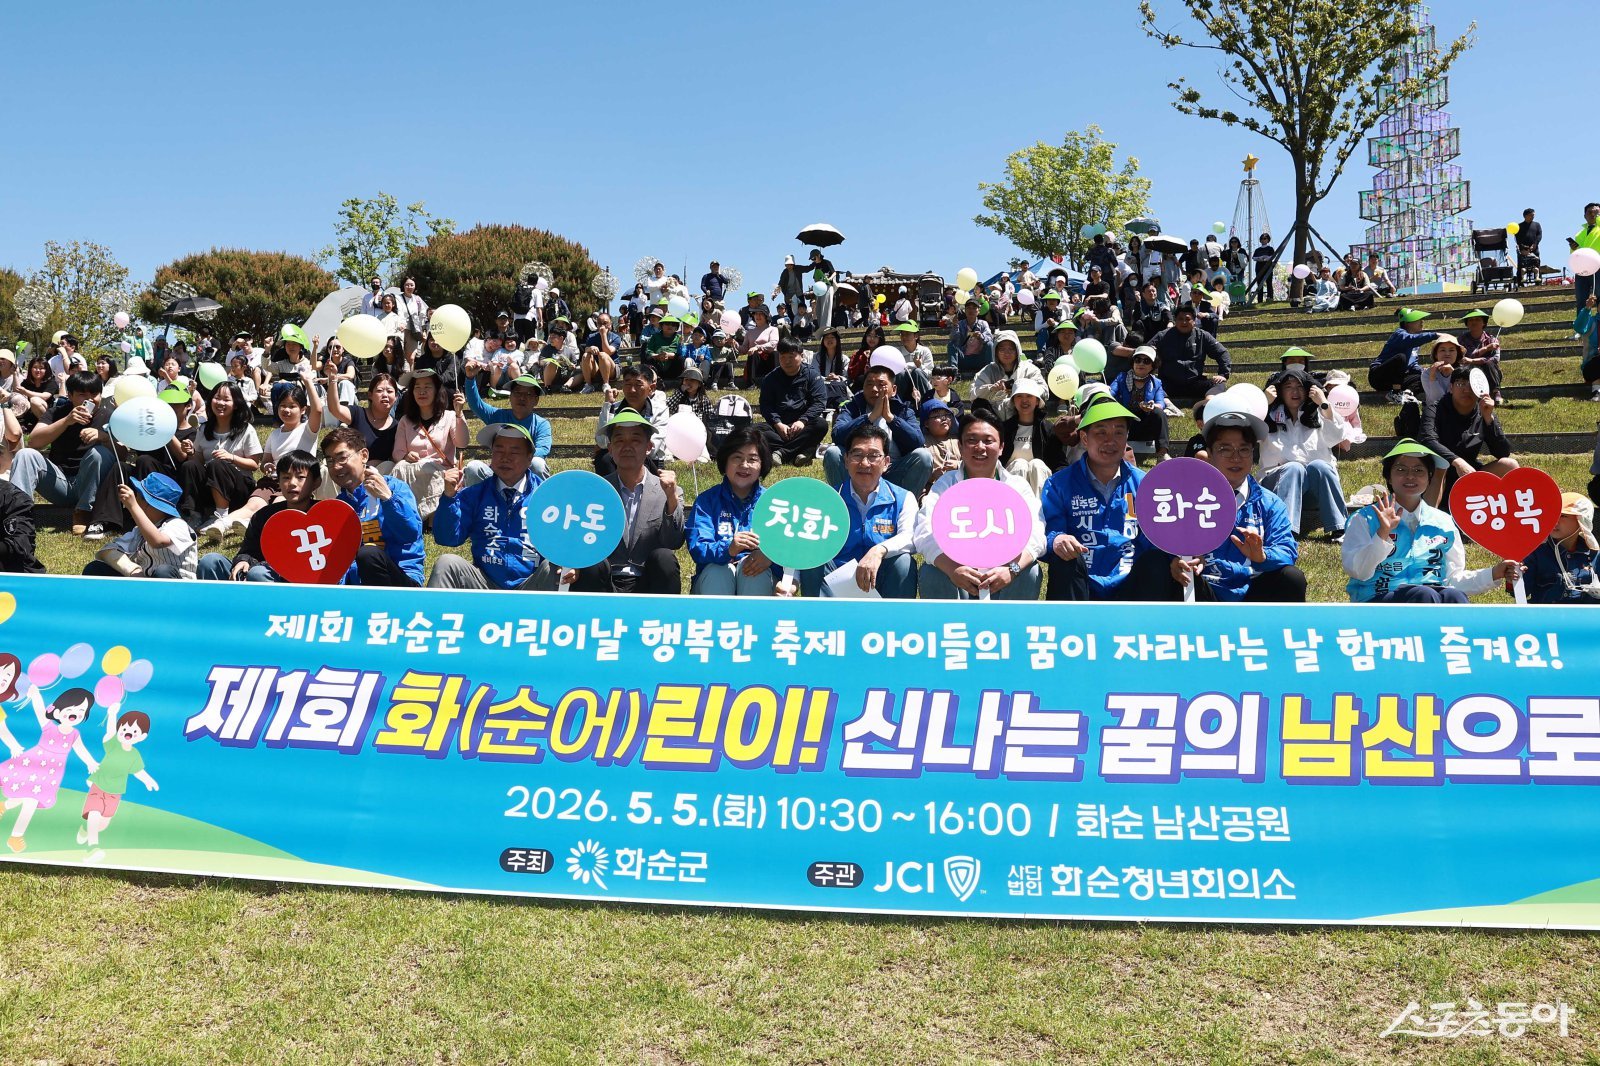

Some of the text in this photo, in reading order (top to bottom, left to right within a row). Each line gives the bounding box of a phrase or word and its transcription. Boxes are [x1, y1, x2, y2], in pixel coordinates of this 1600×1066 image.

[541, 503, 607, 545] 아동
[764, 498, 839, 540] 친화
[948, 505, 1015, 539] 도시
[1152, 486, 1221, 529] 화순
[1465, 488, 1543, 534] 행복
[290, 524, 333, 572] 꿈
[264, 610, 1564, 675] 제1회 화순군 어린이날 행복한 축제 아이들의 꿈이 자라나는 날 함께 즐겨요!
[185, 666, 380, 748] 제1회
[842, 690, 1080, 774] 신나는
[1100, 694, 1260, 776] 꿈의
[1281, 695, 1600, 778] 남산으로
[777, 796, 883, 833] 10:30
[924, 801, 1032, 837] 16:00
[1076, 803, 1144, 840] 화순
[1152, 805, 1291, 842] 남산공원
[507, 850, 547, 873] 주최
[613, 847, 708, 883] 화순군
[814, 863, 856, 886] 주관
[873, 861, 935, 894] JCI
[1007, 865, 1043, 881] 사단
[1007, 880, 1043, 897] 법인
[1050, 863, 1297, 901] 화순청년회의소
